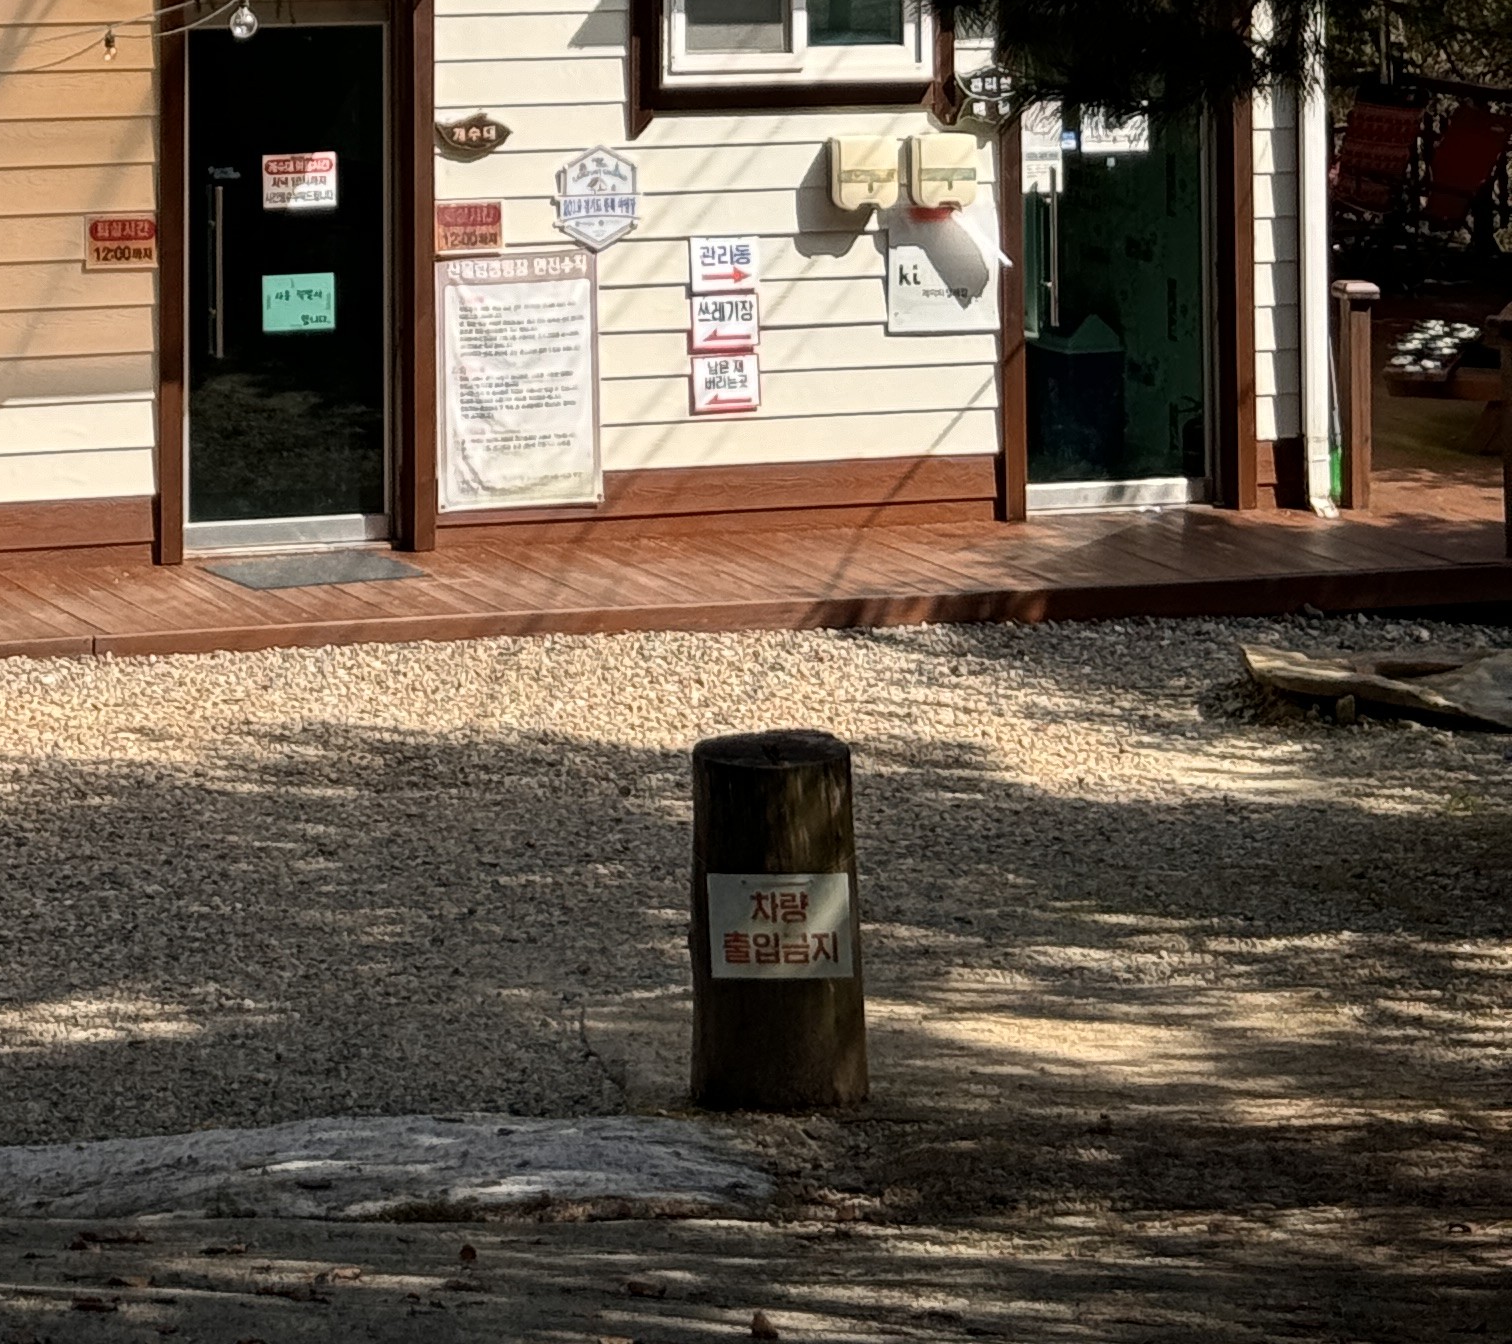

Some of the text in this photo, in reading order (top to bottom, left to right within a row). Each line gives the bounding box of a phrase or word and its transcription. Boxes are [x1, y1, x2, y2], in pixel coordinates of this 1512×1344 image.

[452, 125, 496, 143] 개수대
[699, 244, 752, 266] 관리동
[697, 300, 754, 322] 쓰레기장
[707, 360, 730, 376] 남은
[704, 375, 748, 390] 버리는곳
[749, 890, 809, 924] 차량
[723, 930, 839, 965] 출입금지
